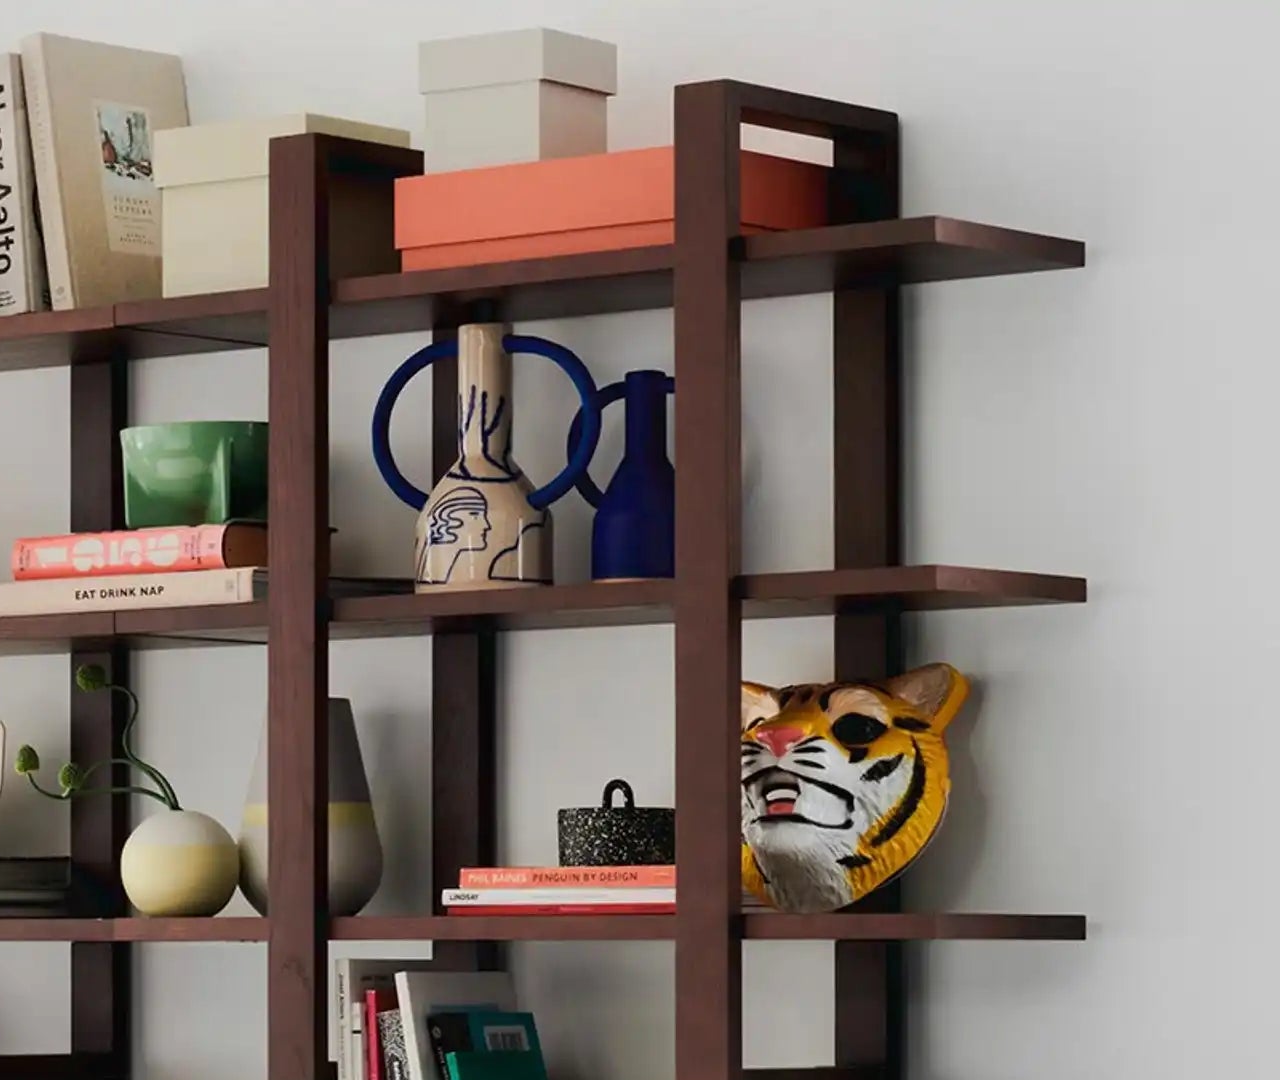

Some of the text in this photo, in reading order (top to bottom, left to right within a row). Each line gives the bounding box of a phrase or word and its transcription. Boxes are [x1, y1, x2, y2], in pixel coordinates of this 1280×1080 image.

[75, 586, 165, 600] EAT DRINK NAP
[532, 873, 580, 883] PENGUIN
[583, 872, 596, 883] BY
[600, 871, 638, 882] DESIGN
